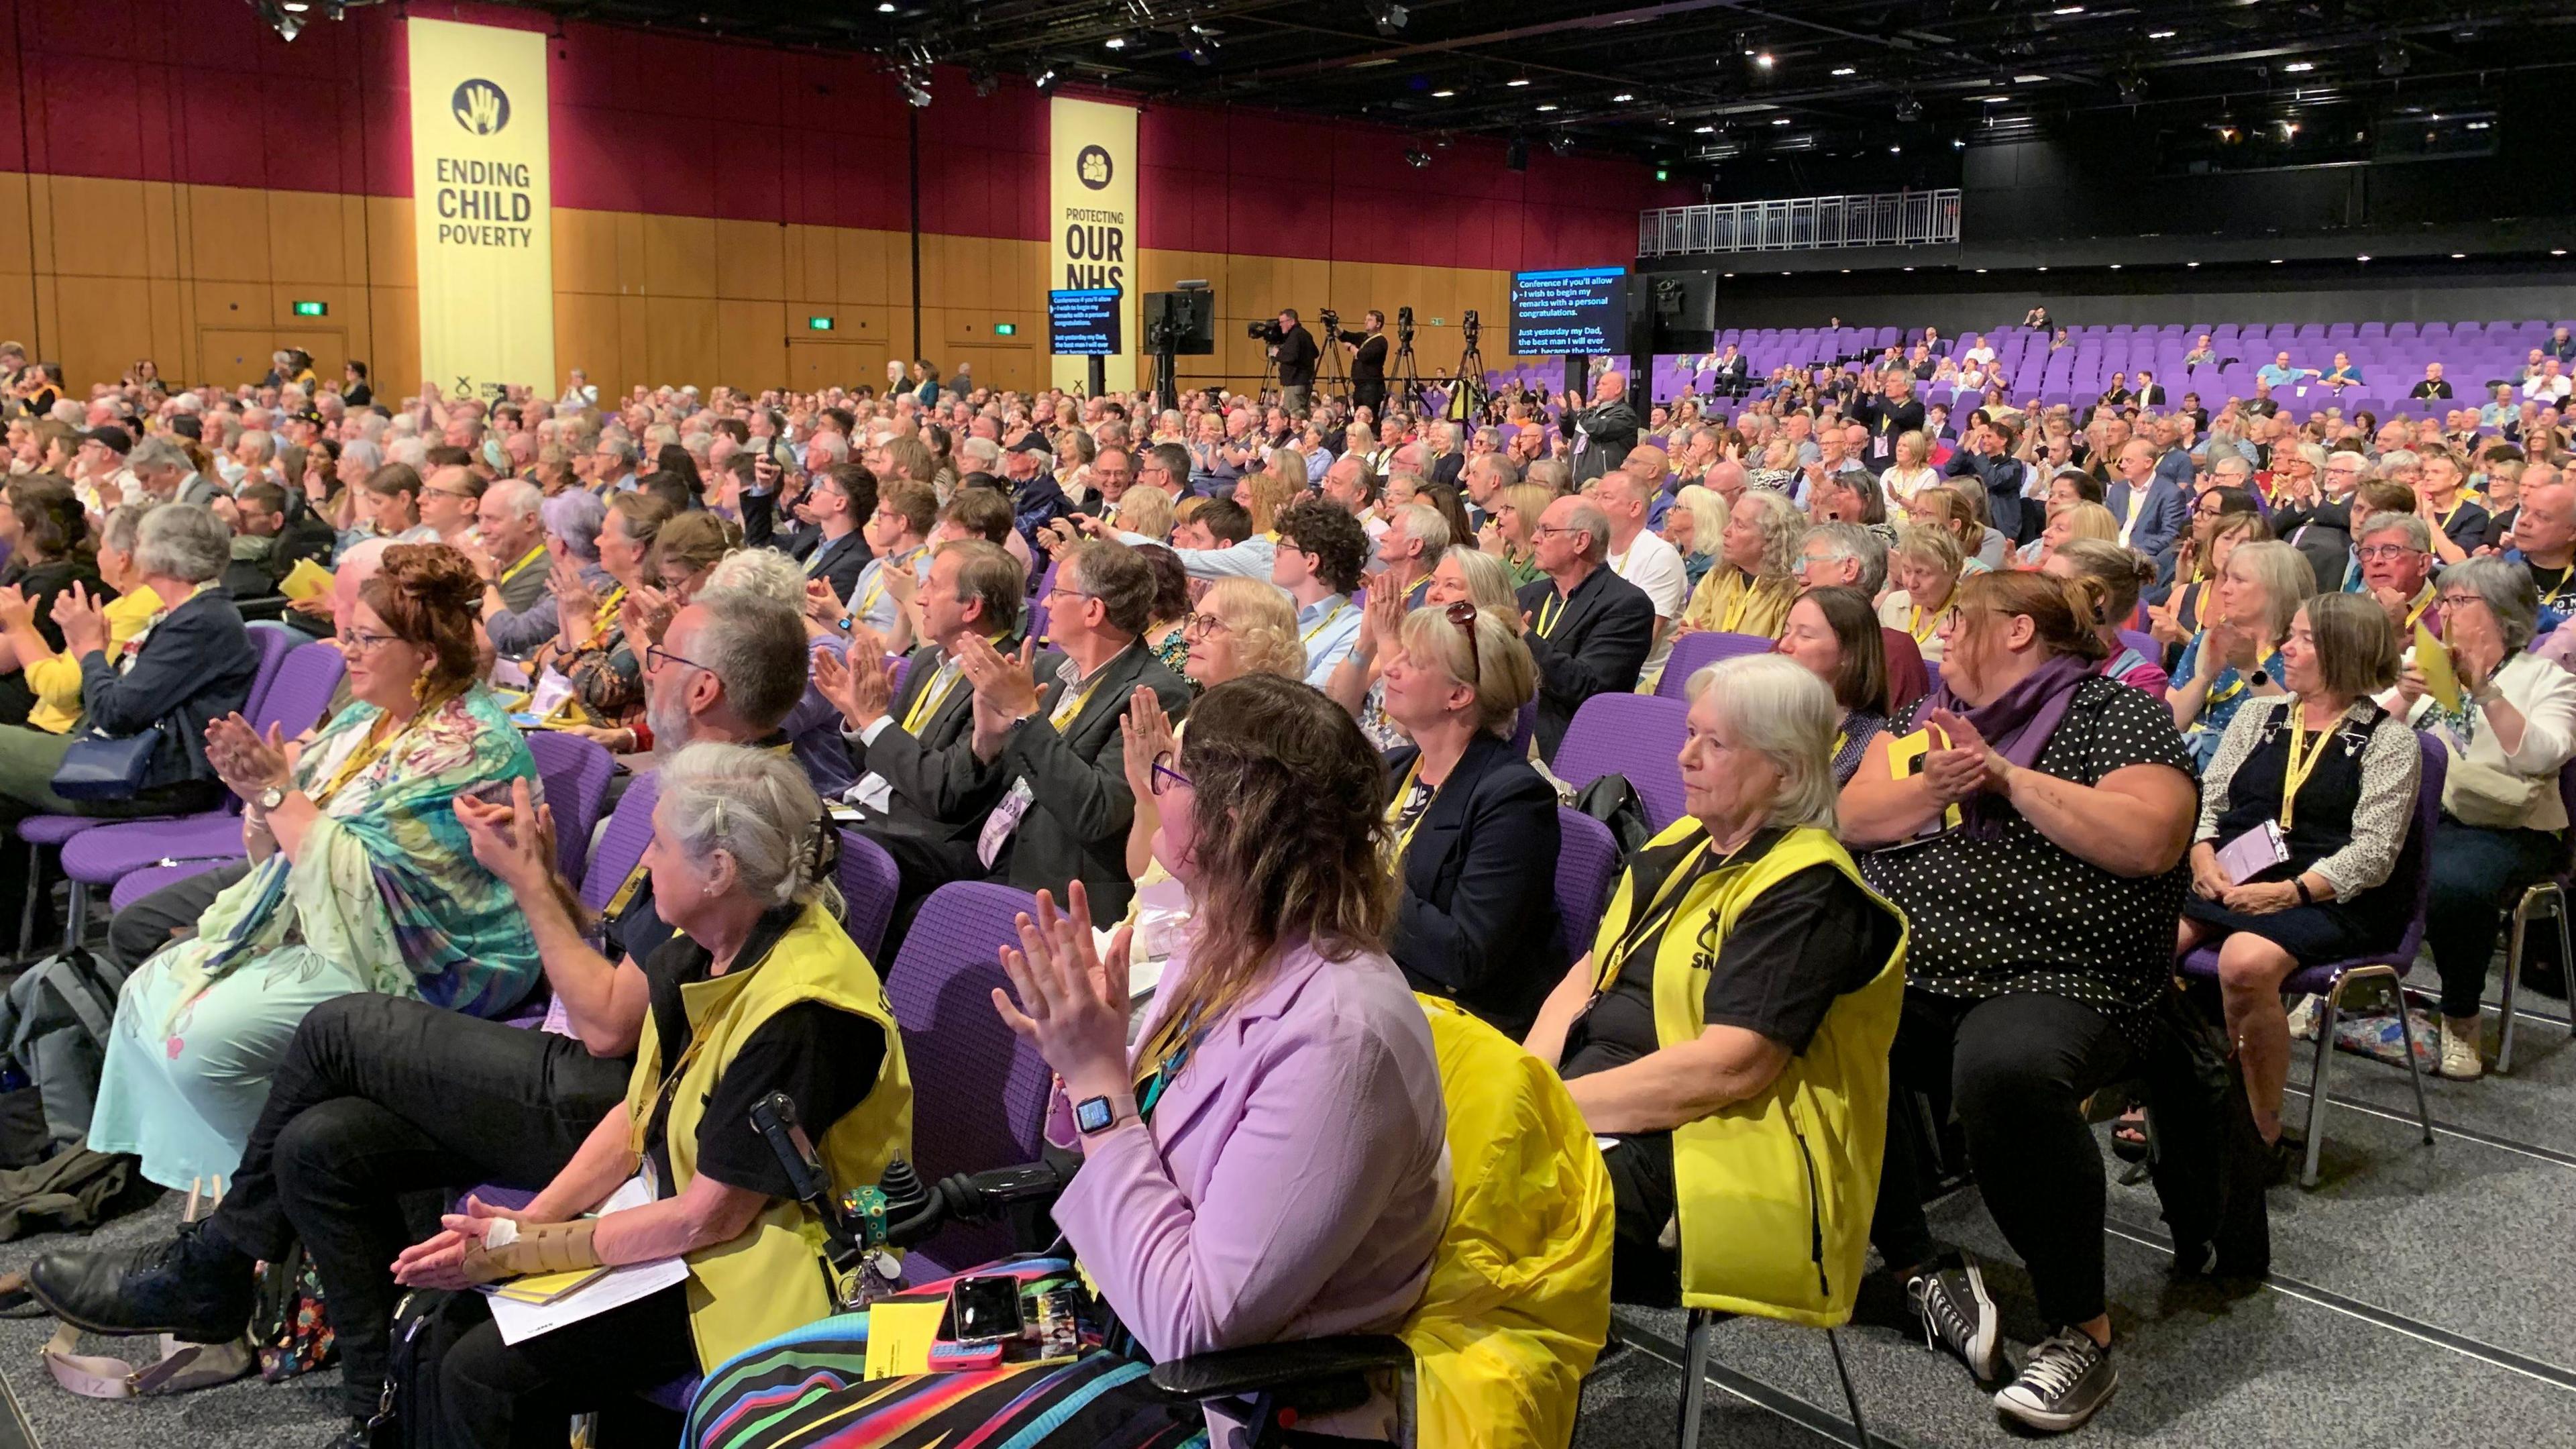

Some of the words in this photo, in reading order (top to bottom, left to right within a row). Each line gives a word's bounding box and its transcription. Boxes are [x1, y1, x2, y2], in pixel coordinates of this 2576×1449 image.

[437, 158, 530, 189] ENDING
[437, 187, 531, 223] CHILD
[1065, 207, 1124, 224] PROTECTING
[438, 223, 533, 248] POVERTY
[1066, 223, 1124, 263] OUR
[1067, 263, 1124, 300] NHS
[1519, 280, 1561, 288] Conference
[1569, 278, 1590, 287] you'll
[1591, 276, 1613, 285] allow
[1556, 288, 1576, 298] begin
[1578, 288, 1591, 297] my
[1519, 299, 1549, 308] remarks
[1550, 299, 1567, 307] with
[1575, 297, 1608, 307] personal
[1519, 309, 1578, 318] congratulations.
[1534, 327, 1569, 337] yesterday
[1570, 328, 1583, 336] my
[1585, 327, 1603, 335] Dad,
[1519, 338, 1531, 346] the
[1532, 338, 1548, 346] best
[1572, 337, 1586, 345] will
[1002, 800, 1020, 818] 2024
[1691, 952, 1714, 972] SN
